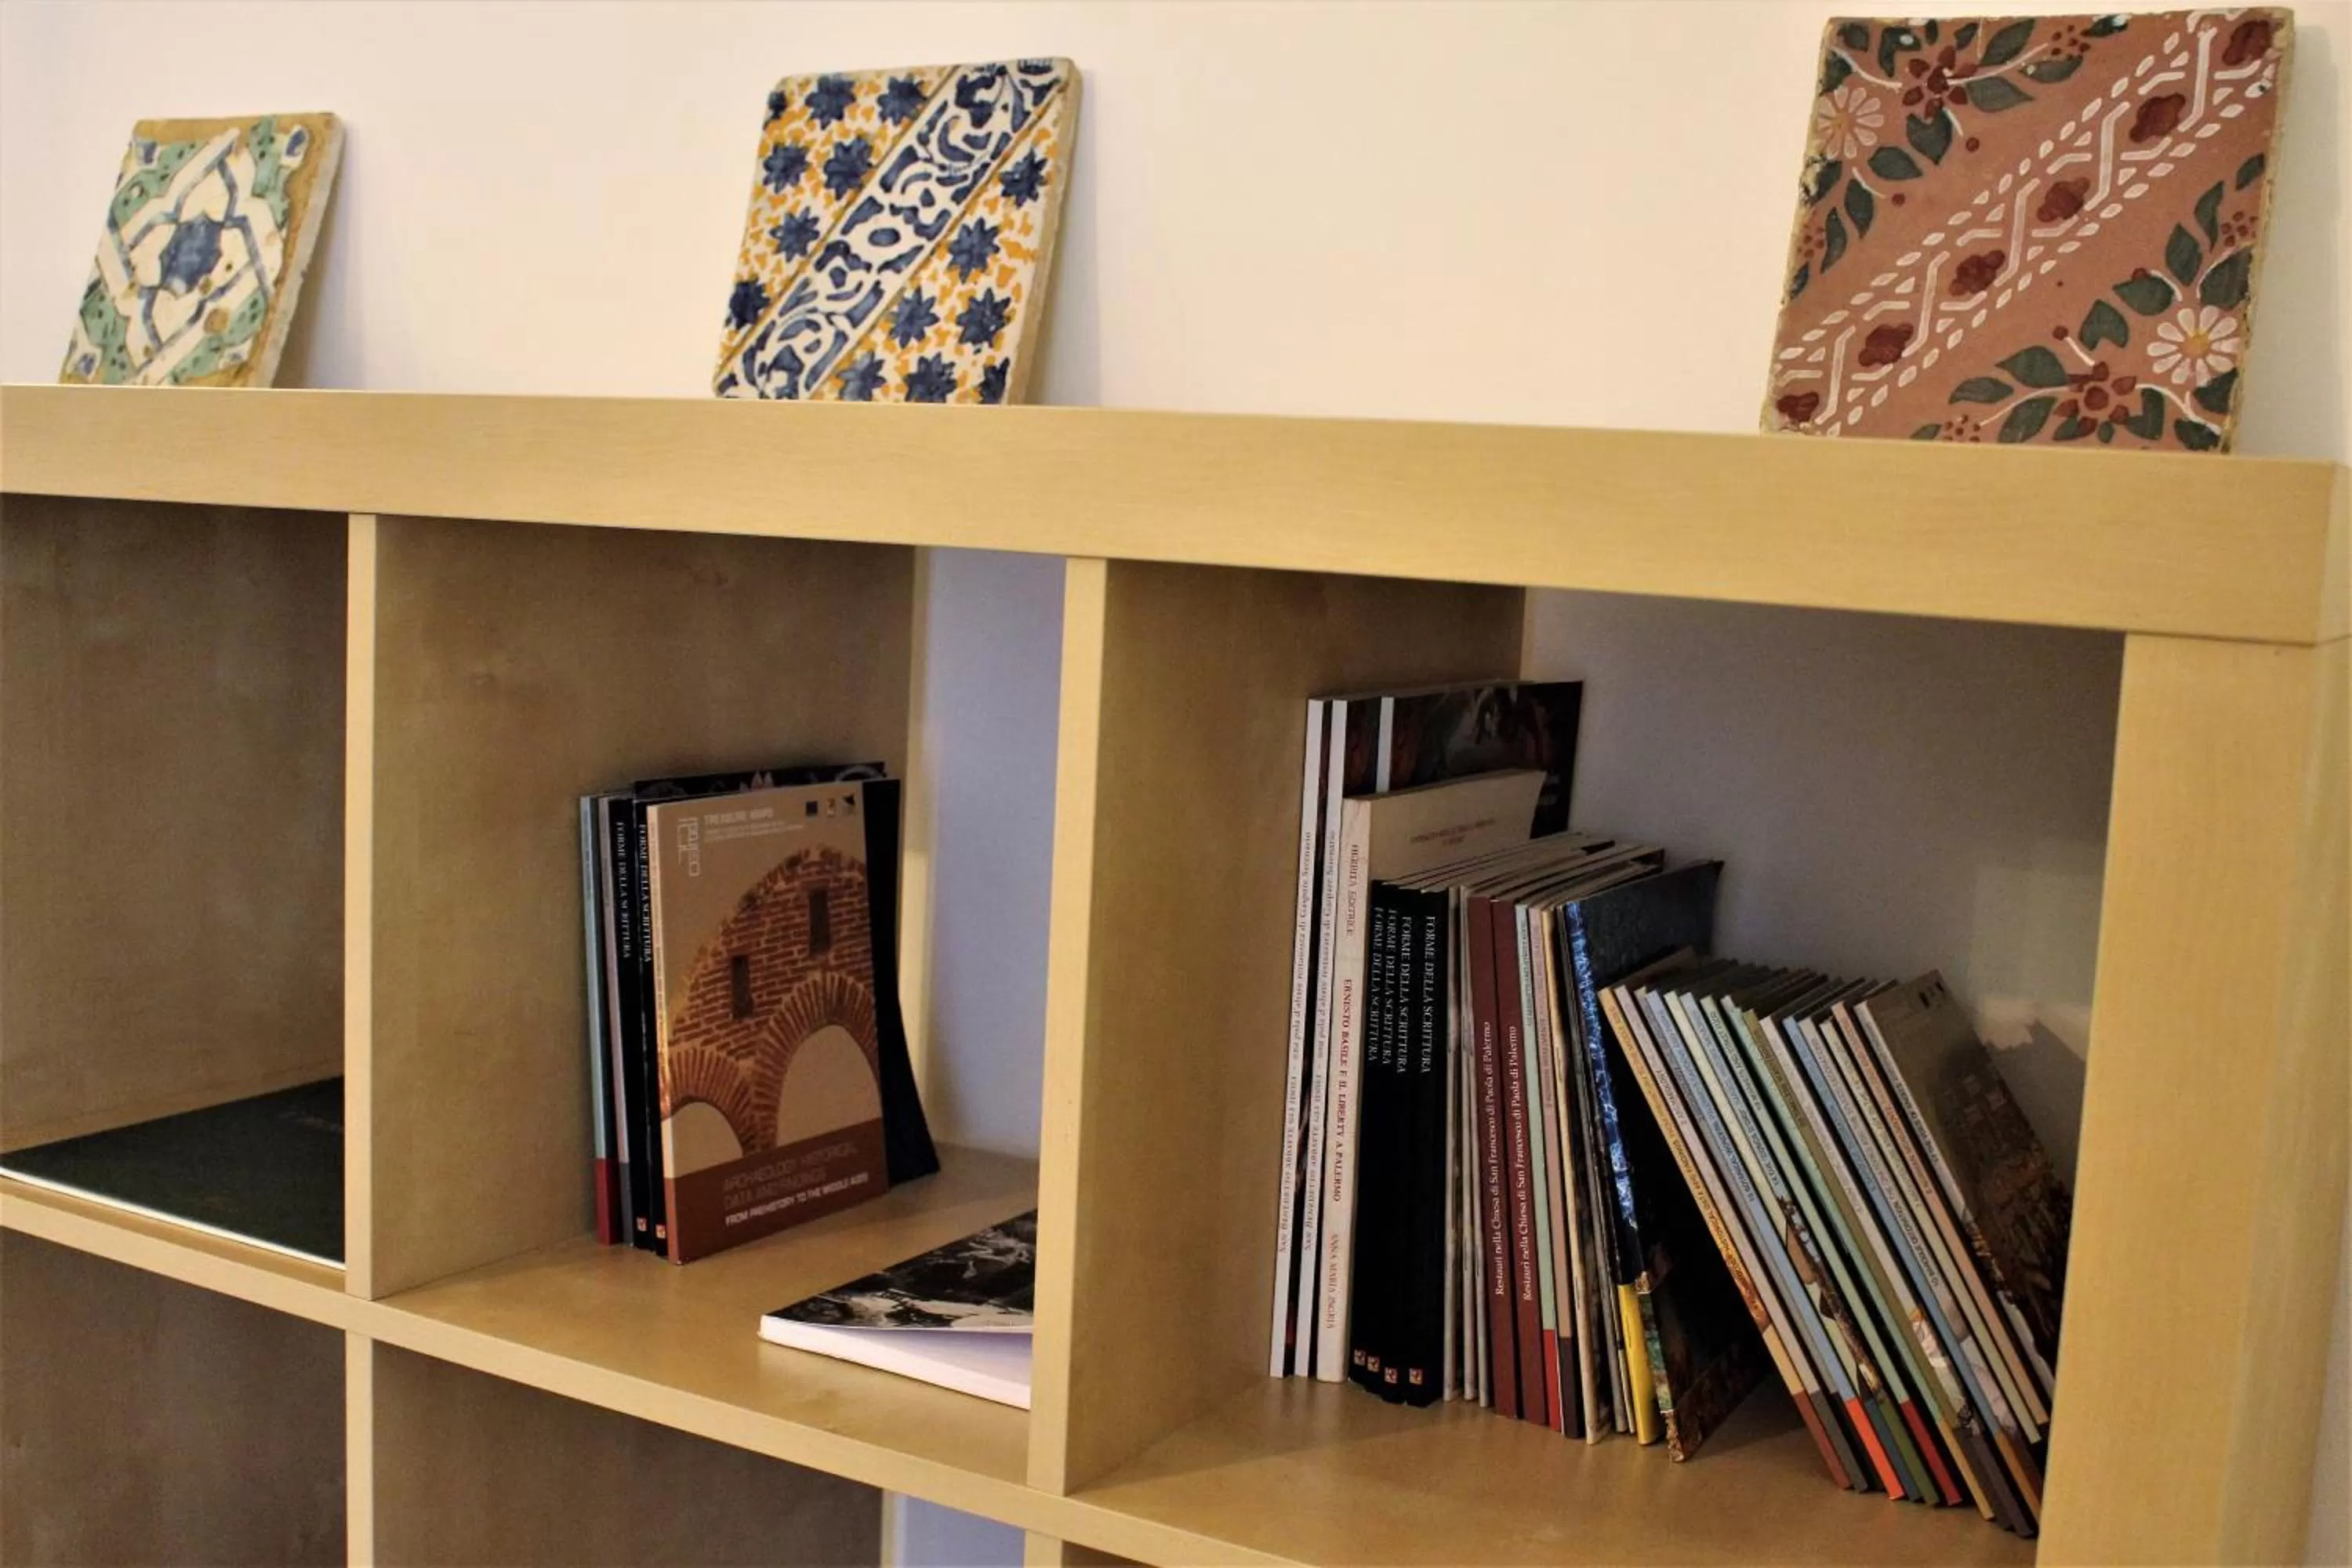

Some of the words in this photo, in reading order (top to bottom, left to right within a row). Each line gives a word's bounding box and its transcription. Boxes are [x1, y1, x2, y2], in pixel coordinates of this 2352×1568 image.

[615, 822, 626, 857] FORME
[637, 824, 648, 858] FORME
[617, 862, 628, 897] DELLA
[638, 865, 649, 899] DELLA
[619, 899, 630, 958] SCRITTURA
[641, 903, 652, 962] SCRITTURA
[1371, 906, 1384, 949] FORME
[1385, 909, 1396, 952] FORME
[1399, 916, 1411, 960] FORME
[1424, 916, 1436, 959] FORME
[1370, 953, 1381, 992] DELLA
[1383, 956, 1395, 995] DELLA
[1398, 963, 1410, 1003] DELLA
[1422, 962, 1434, 1002] DELLA
[1341, 978, 1352, 1027] ERNESTO
[1367, 996, 1380, 1061] SCRITTURA
[1381, 998, 1393, 1064] SCRITTURA
[1396, 1006, 1409, 1073] SCRITTURA
[1419, 1006, 1432, 1073] SCRITTURA
[1481, 1022, 1493, 1062] Palermo
[1507, 1026, 1519, 1065] Palermo
[1339, 1031, 1349, 1066] BASILE
[1483, 1076, 1495, 1103] Paola
[1510, 1080, 1521, 1107] Paola
[1335, 1094, 1346, 1136] LIBERTY
[1486, 1117, 1498, 1163] Francesco
[1512, 1122, 1524, 1168] Francesco
[1331, 1152, 1343, 1201] PALERMO
[1488, 1166, 1499, 1183] San
[1515, 1171, 1526, 1188] San
[725, 1210, 749, 1226] FROM
[1490, 1197, 1501, 1229] Chiesa
[1516, 1202, 1528, 1234] Chiesa
[1328, 1233, 1338, 1258] ANNA
[1492, 1231, 1503, 1253] nella
[1519, 1236, 1530, 1259] nella
[1327, 1263, 1336, 1292] MARIA
[1493, 1256, 1504, 1294] Restauri
[1520, 1261, 1532, 1300] Restauri
